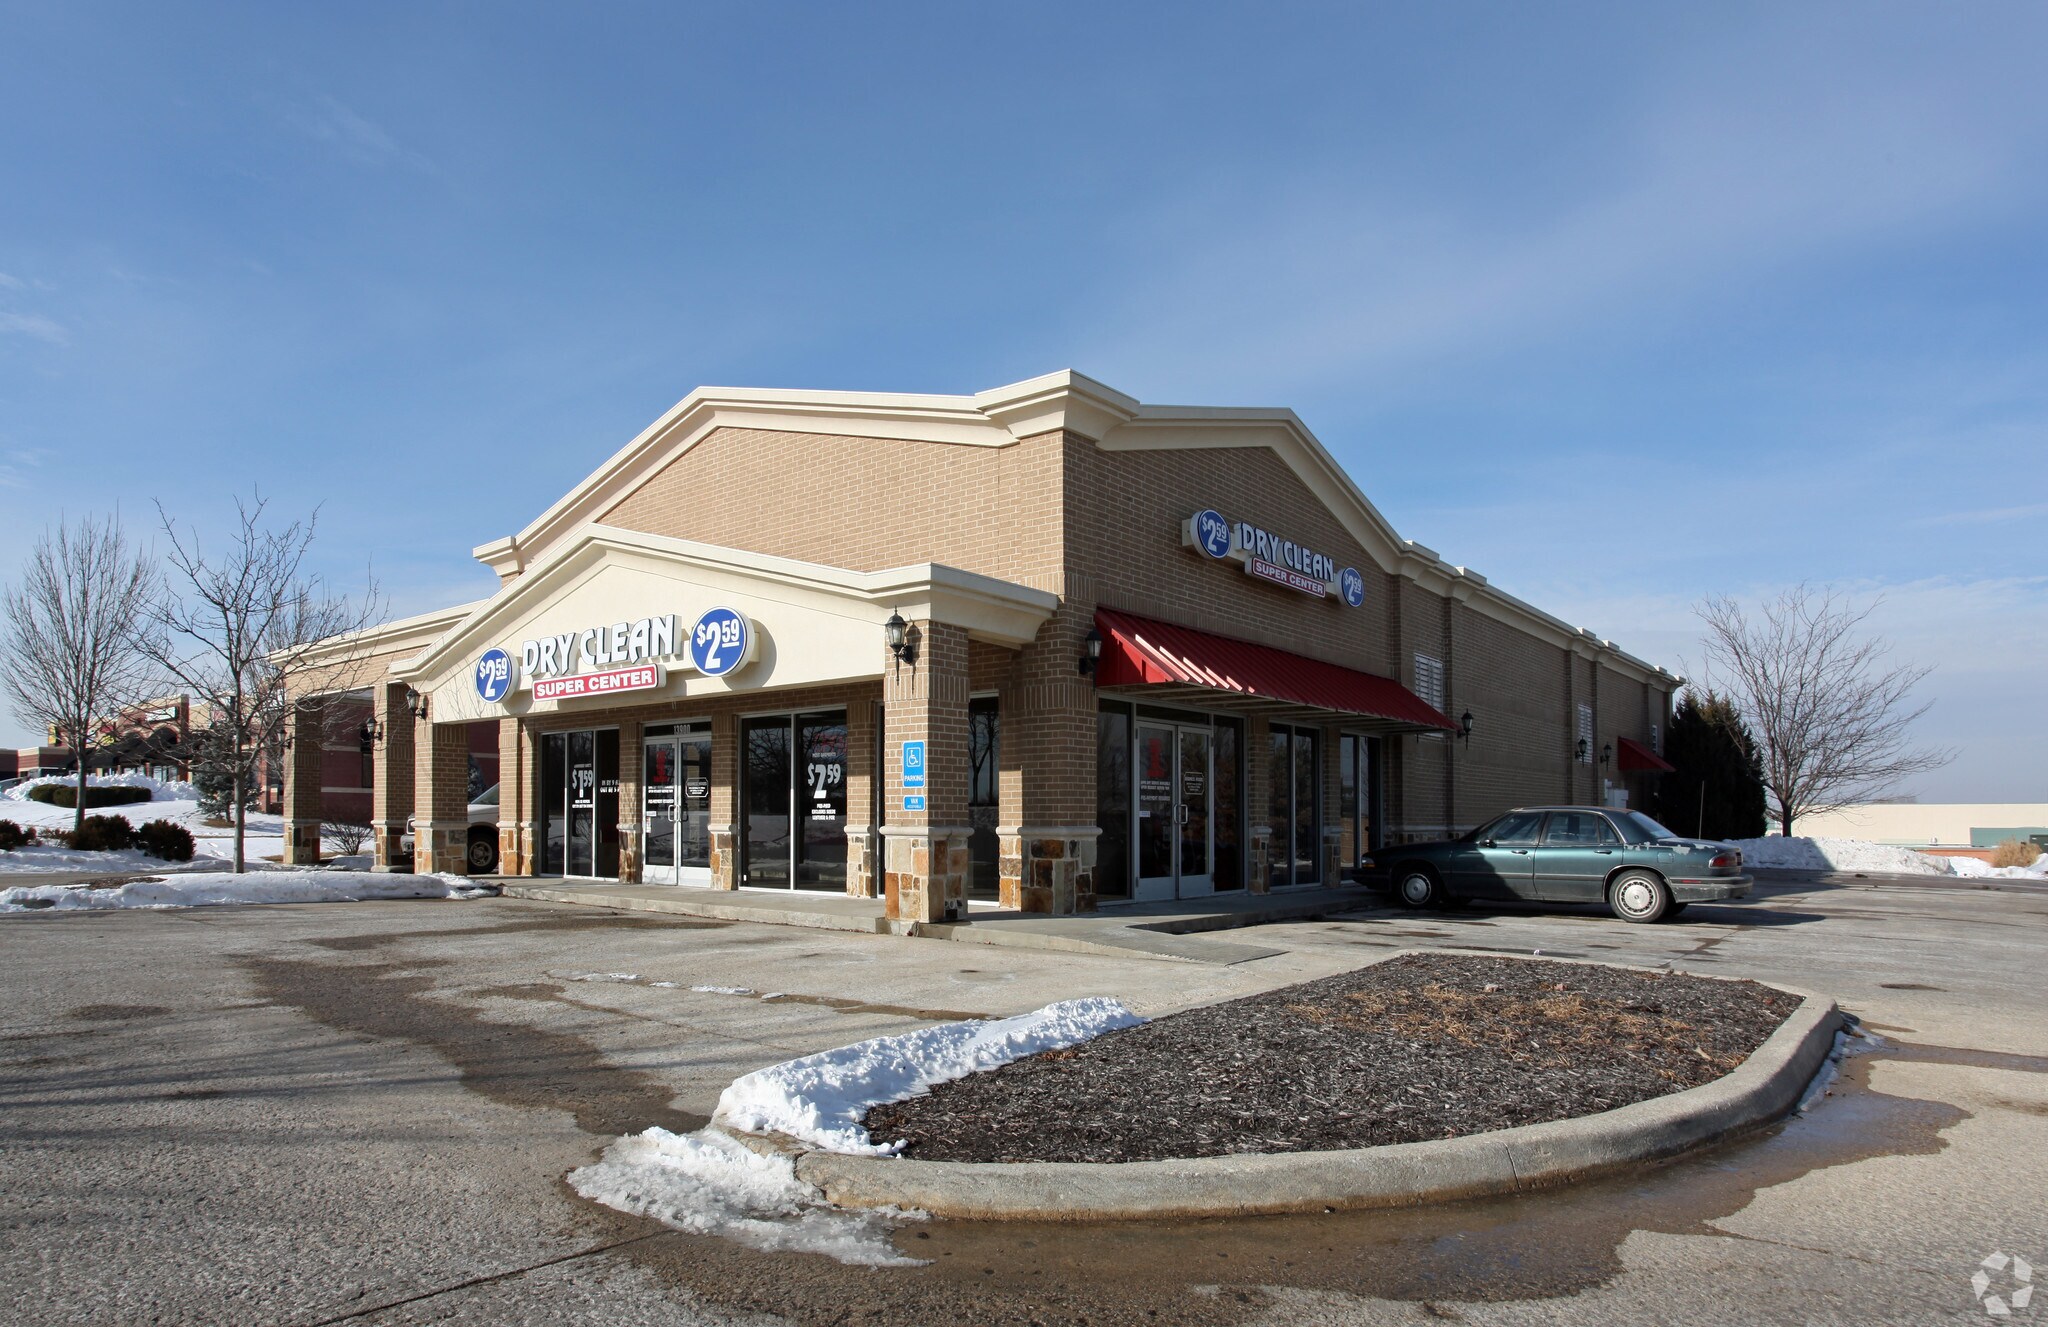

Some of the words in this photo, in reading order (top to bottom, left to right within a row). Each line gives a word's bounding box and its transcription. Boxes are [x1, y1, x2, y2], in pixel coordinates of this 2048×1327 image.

[1242, 522, 1279, 564] DRY
[1283, 541, 1334, 581] CLEAN
[1255, 562, 1287, 582] SUPER
[1289, 574, 1324, 595] CENTER
[522, 632, 576, 676] DRY
[580, 614, 675, 665] CLEAN
[536, 678, 585, 697] SUPER
[588, 669, 652, 691] CENTER
[904, 774, 924, 782] PARKING
